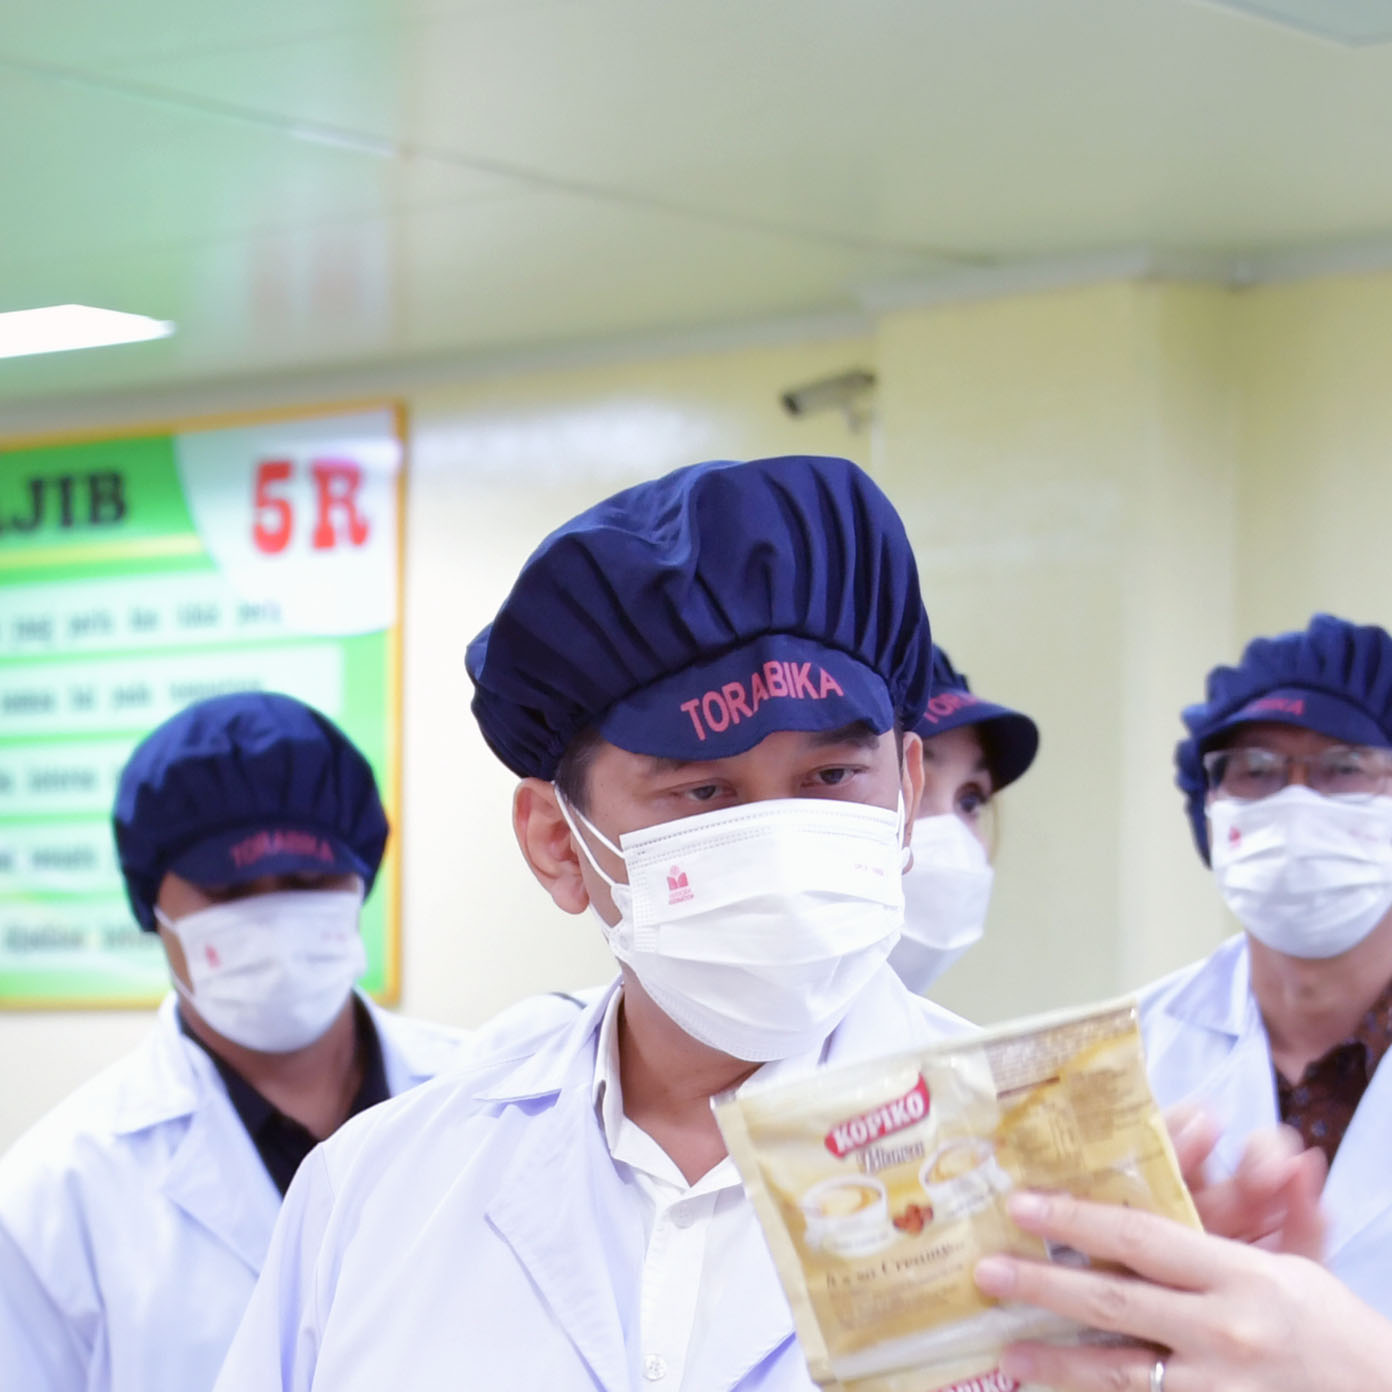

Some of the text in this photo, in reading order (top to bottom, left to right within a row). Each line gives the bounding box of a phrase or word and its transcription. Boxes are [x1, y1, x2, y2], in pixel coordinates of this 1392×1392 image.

[251, 458, 370, 556] 5R
[680, 660, 845, 741] TORABIKA
[833, 1091, 925, 1151] KOPIKO
